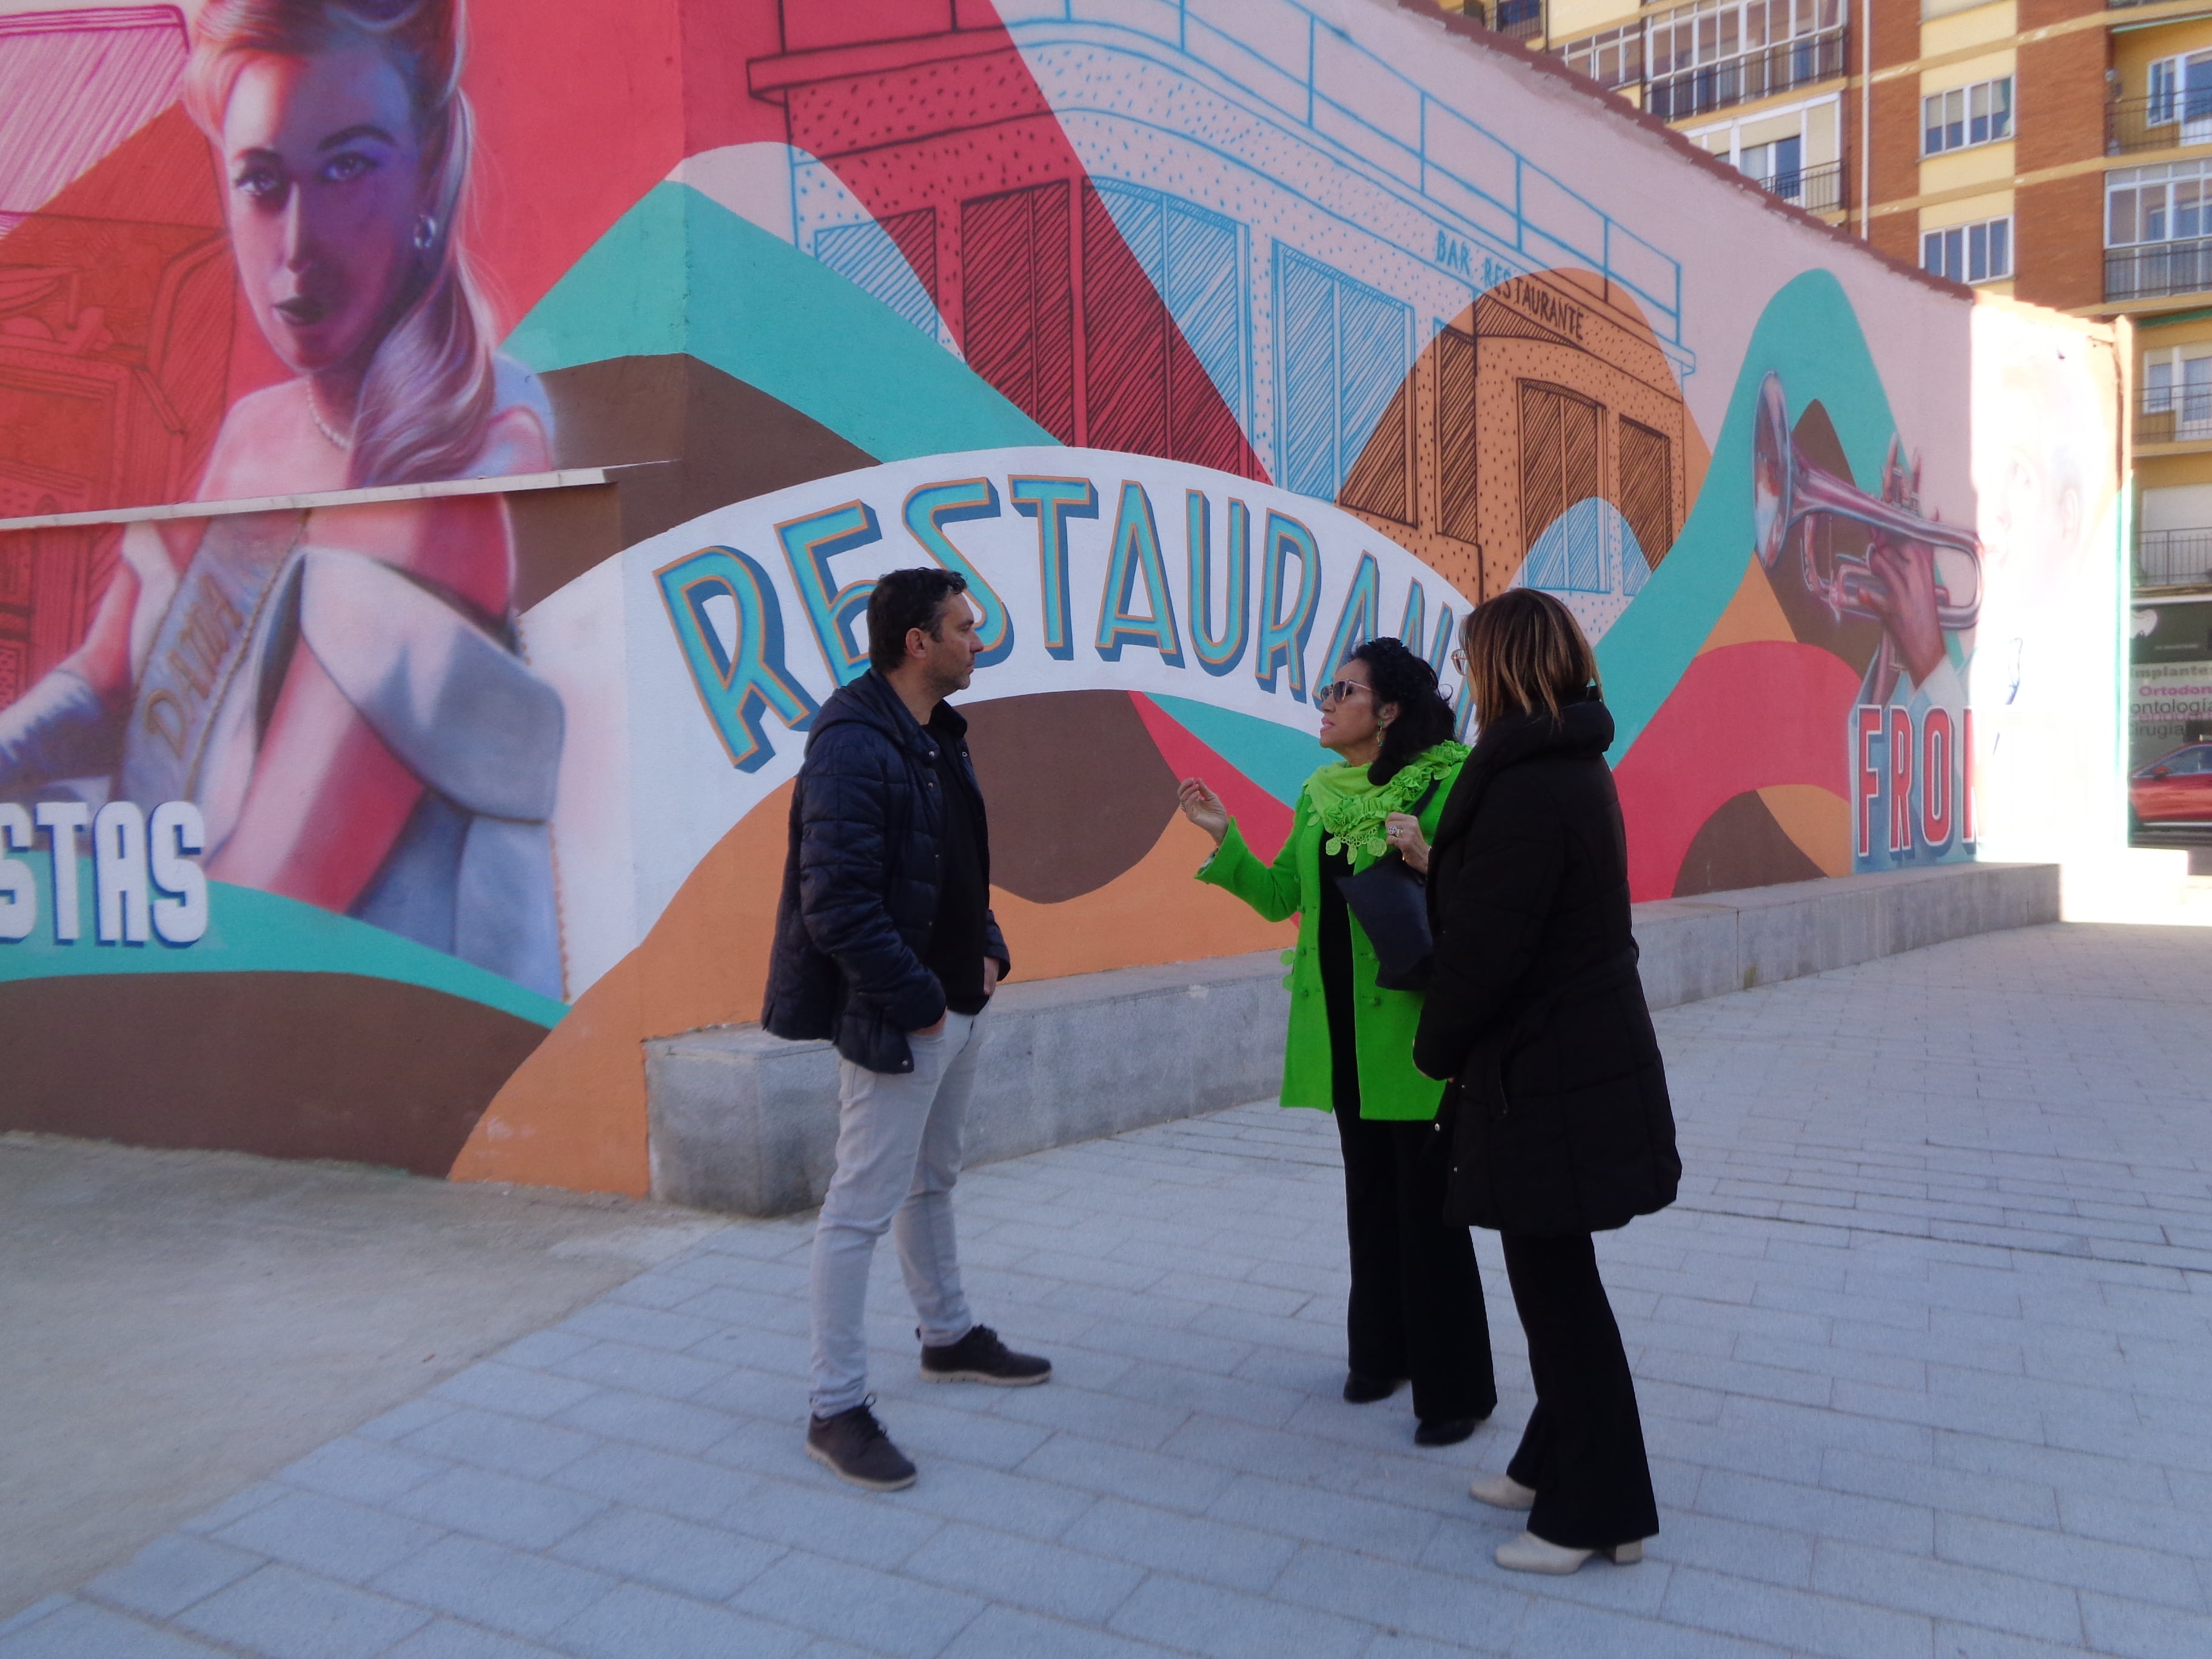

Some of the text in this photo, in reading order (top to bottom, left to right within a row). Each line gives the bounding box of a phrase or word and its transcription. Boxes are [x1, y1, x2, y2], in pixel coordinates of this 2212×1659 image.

[1435, 229, 1584, 341] BAR RESTAURANTE
[653, 474, 1480, 774] RESTAURAN
